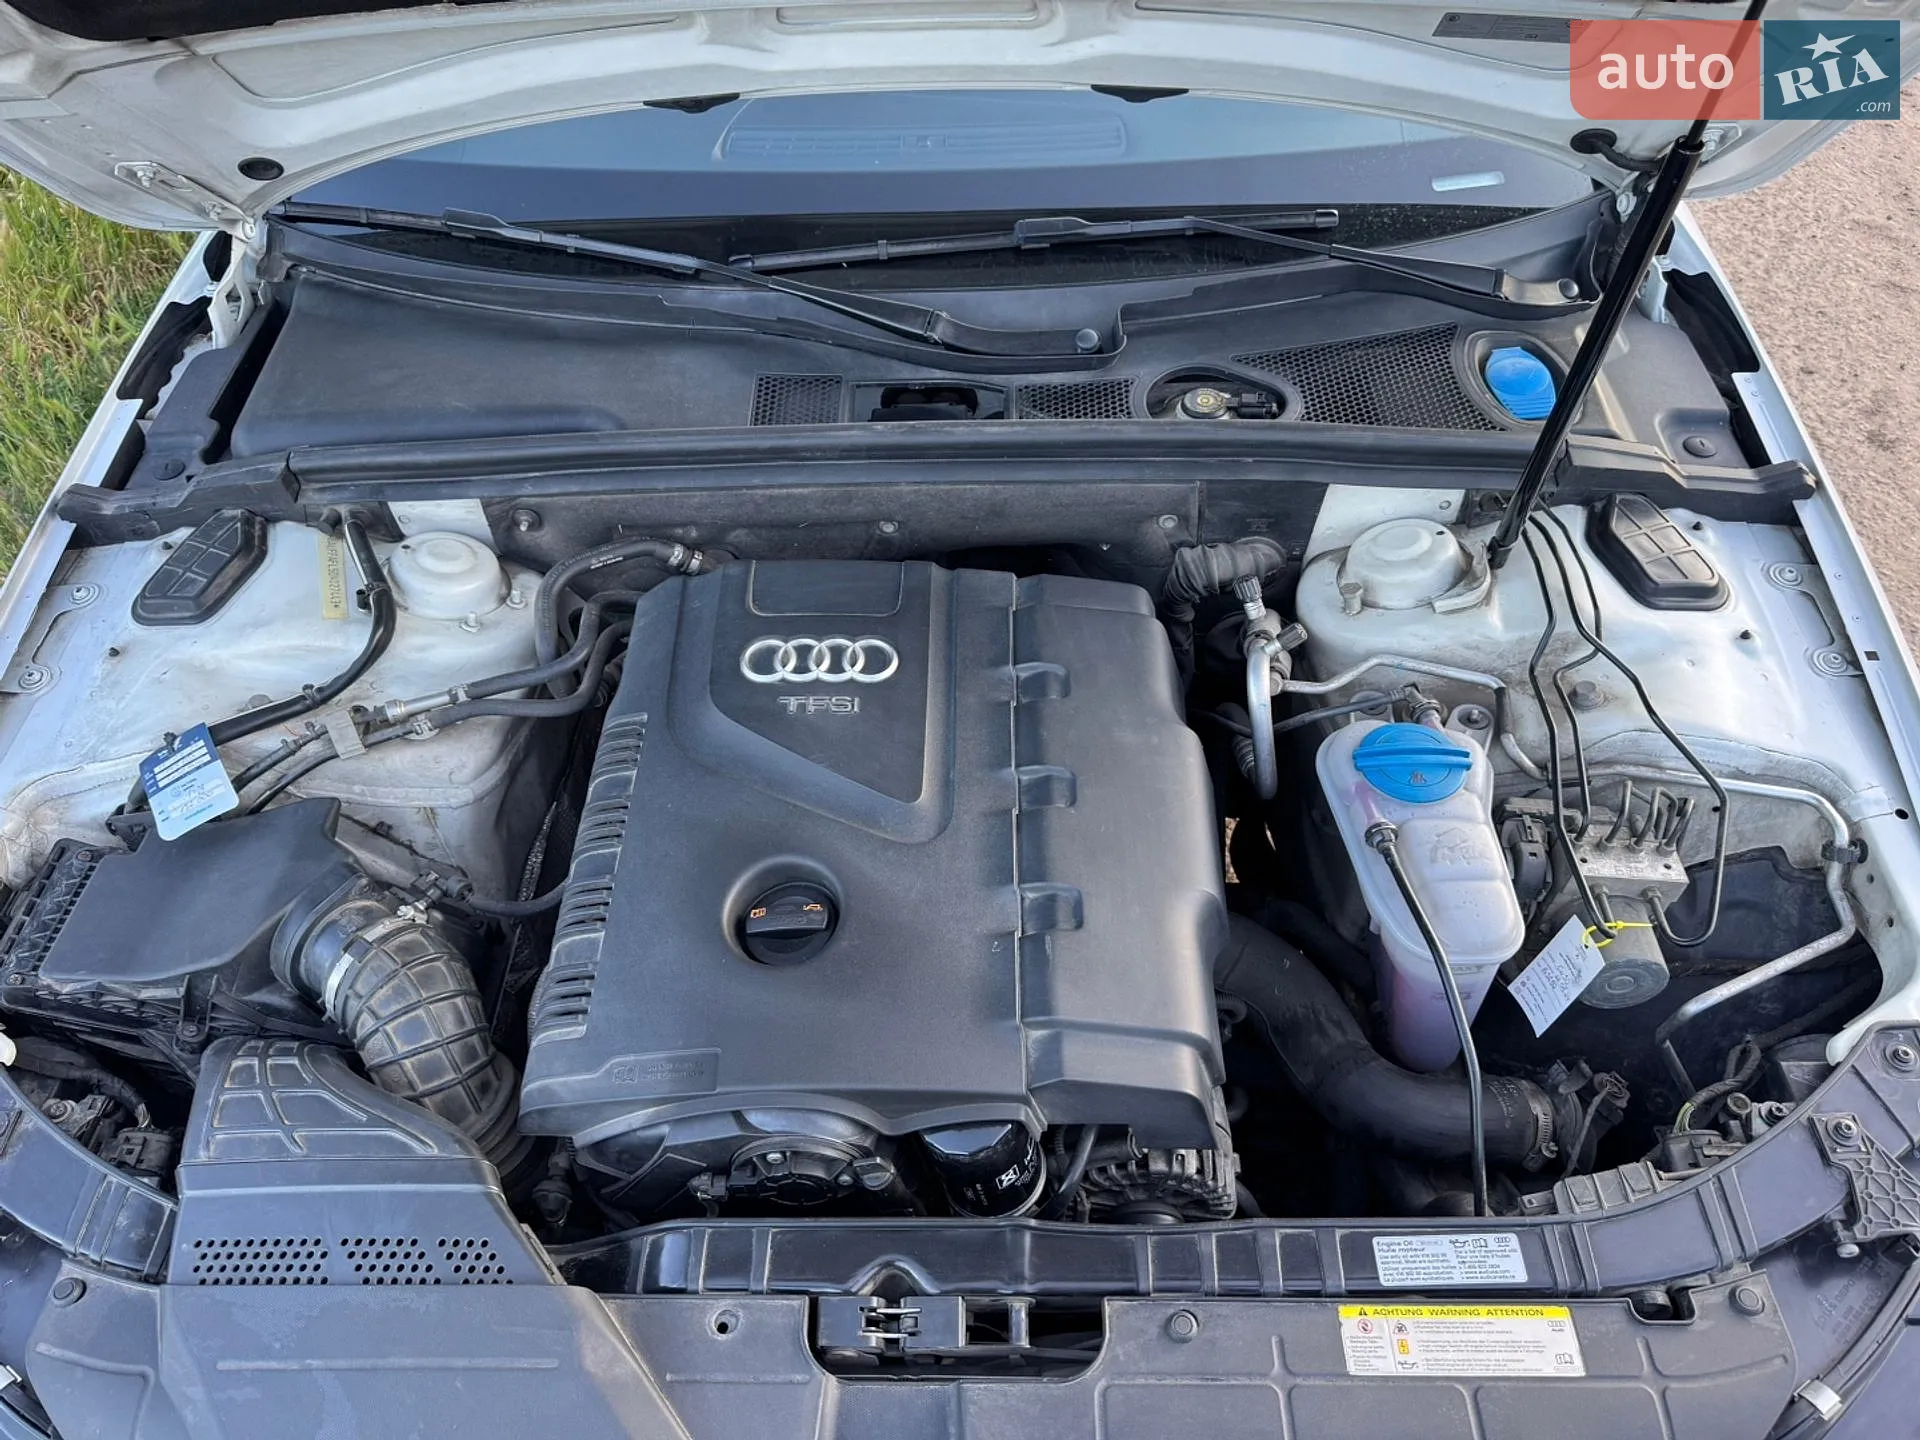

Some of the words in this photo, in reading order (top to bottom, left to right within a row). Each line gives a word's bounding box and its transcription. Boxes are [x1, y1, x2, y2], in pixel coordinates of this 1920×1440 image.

[777, 696, 860, 715] TFSI
[1373, 1308, 1424, 1316] ACHTUNG
[1428, 1308, 1480, 1316] WARNING
[1486, 1308, 1544, 1316] ATTENTION
